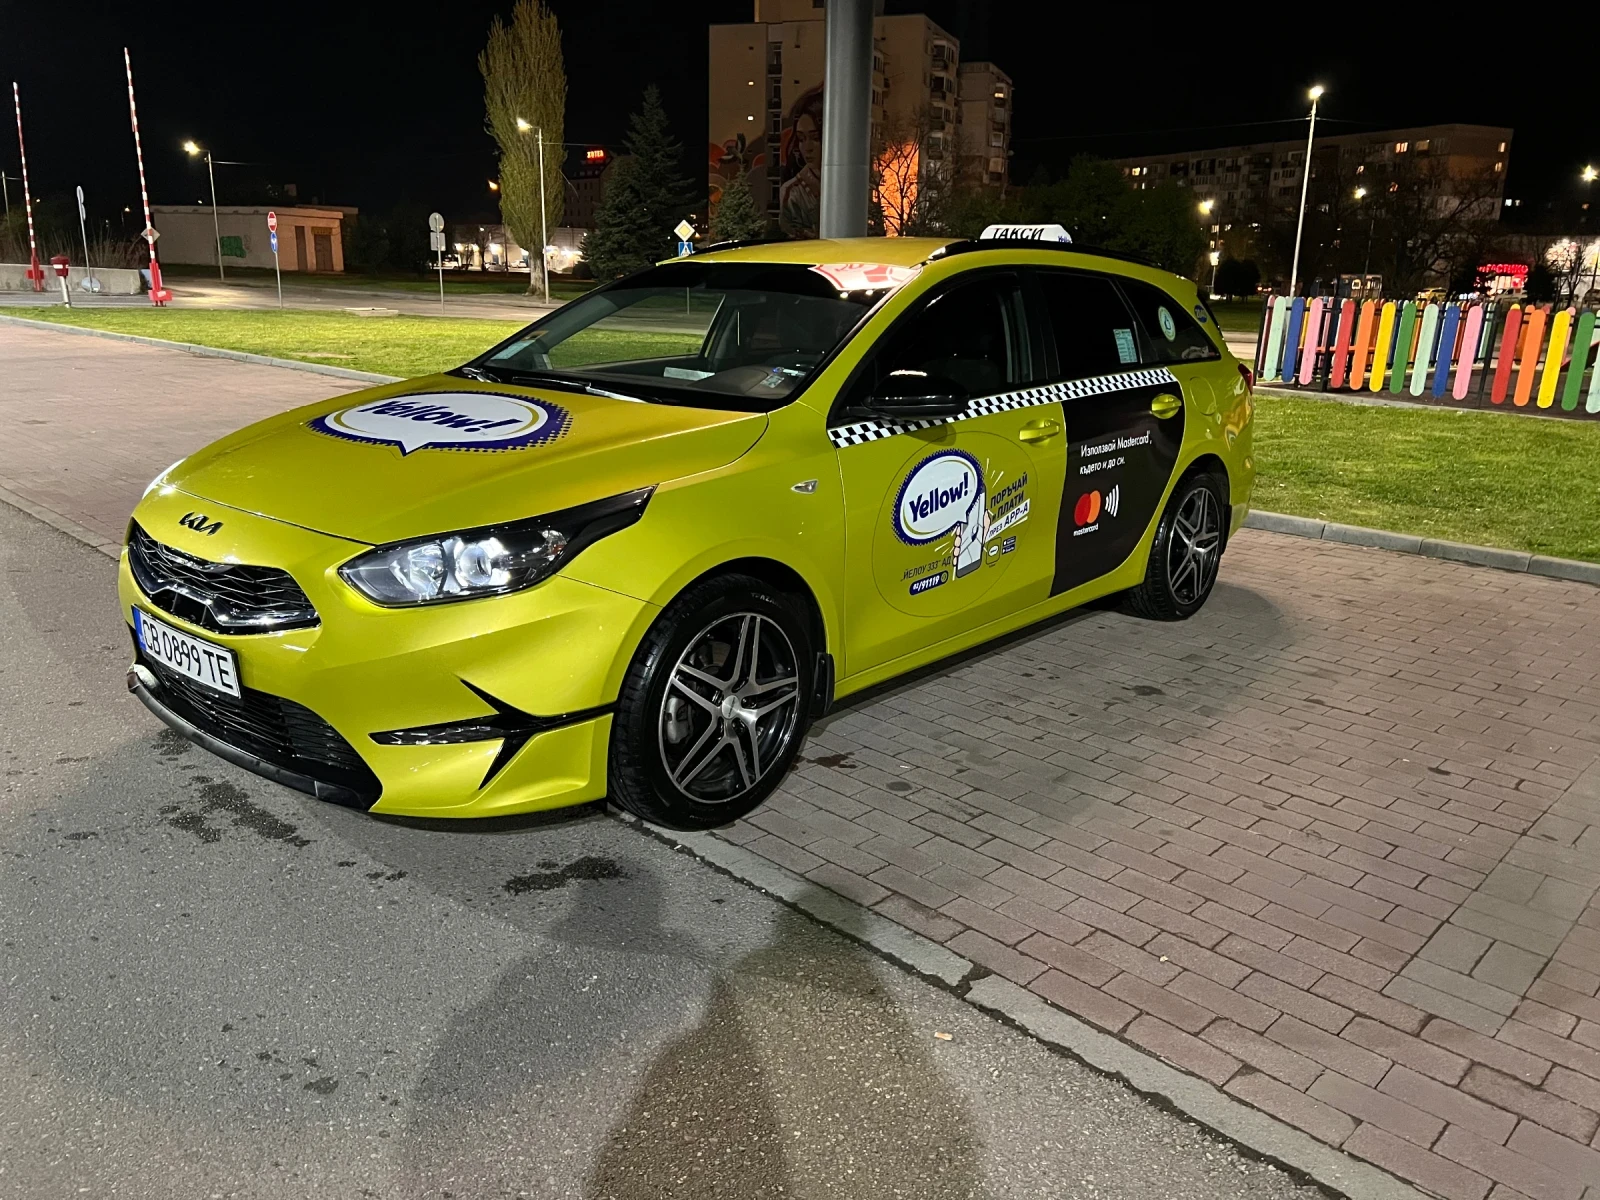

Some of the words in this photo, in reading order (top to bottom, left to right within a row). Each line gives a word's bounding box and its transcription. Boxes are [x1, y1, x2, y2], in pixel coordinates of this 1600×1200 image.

[993, 228, 1044, 240] ТАКСИ
[357, 400, 523, 433] Yellow!
[1080, 440, 1116, 457] Използвай
[1080, 461, 1102, 475] където
[1107, 459, 1116, 470] да
[909, 471, 969, 523] Yellow!
[990, 471, 1028, 508] ПОРЪЧАЙ
[997, 490, 1025, 519] ПЛАТИ
[178, 511, 224, 536] KIA
